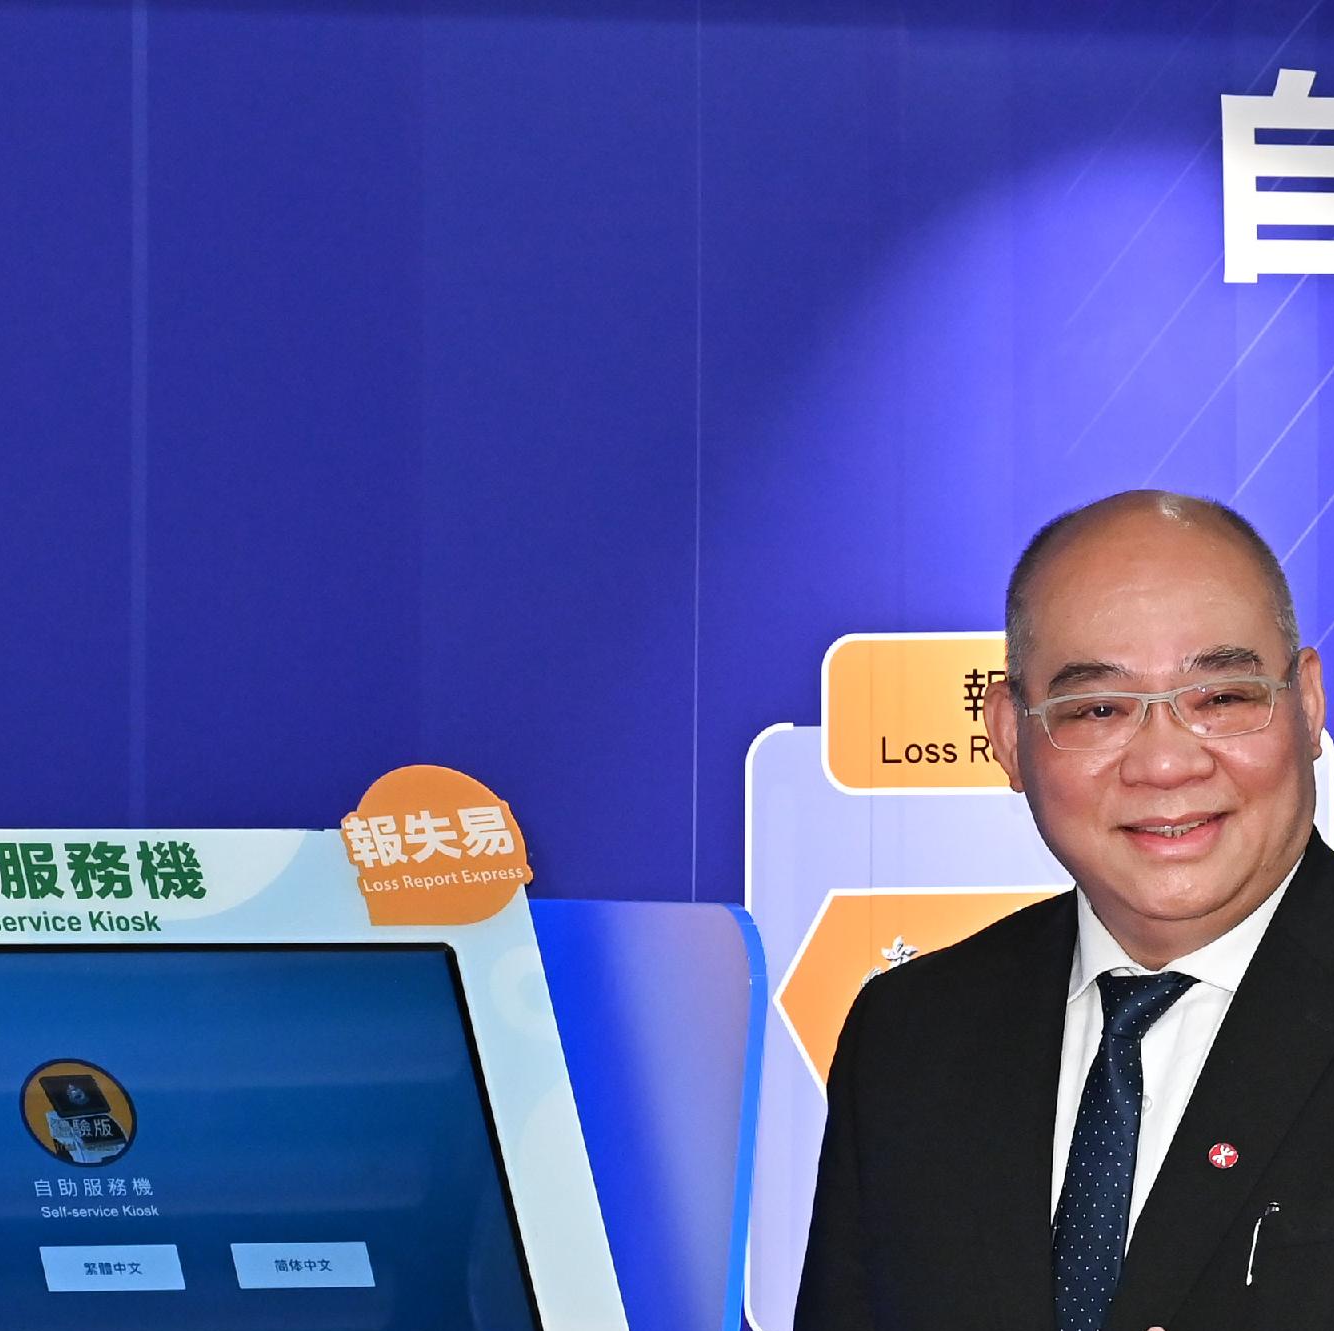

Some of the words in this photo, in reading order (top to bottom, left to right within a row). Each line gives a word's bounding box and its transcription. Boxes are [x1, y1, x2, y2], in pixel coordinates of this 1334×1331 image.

[882, 735, 958, 764] Loss
[344, 806, 515, 868] 報失易
[363, 877, 400, 893] Loss
[402, 871, 459, 890] Report
[461, 867, 524, 885] Express
[89, 910, 162, 932] Kiosk
[34, 1177, 154, 1197] 自助服務機
[40, 1205, 119, 1219] Self-service
[122, 1204, 160, 1217] Kiosk
[274, 1258, 333, 1273] 简体中文
